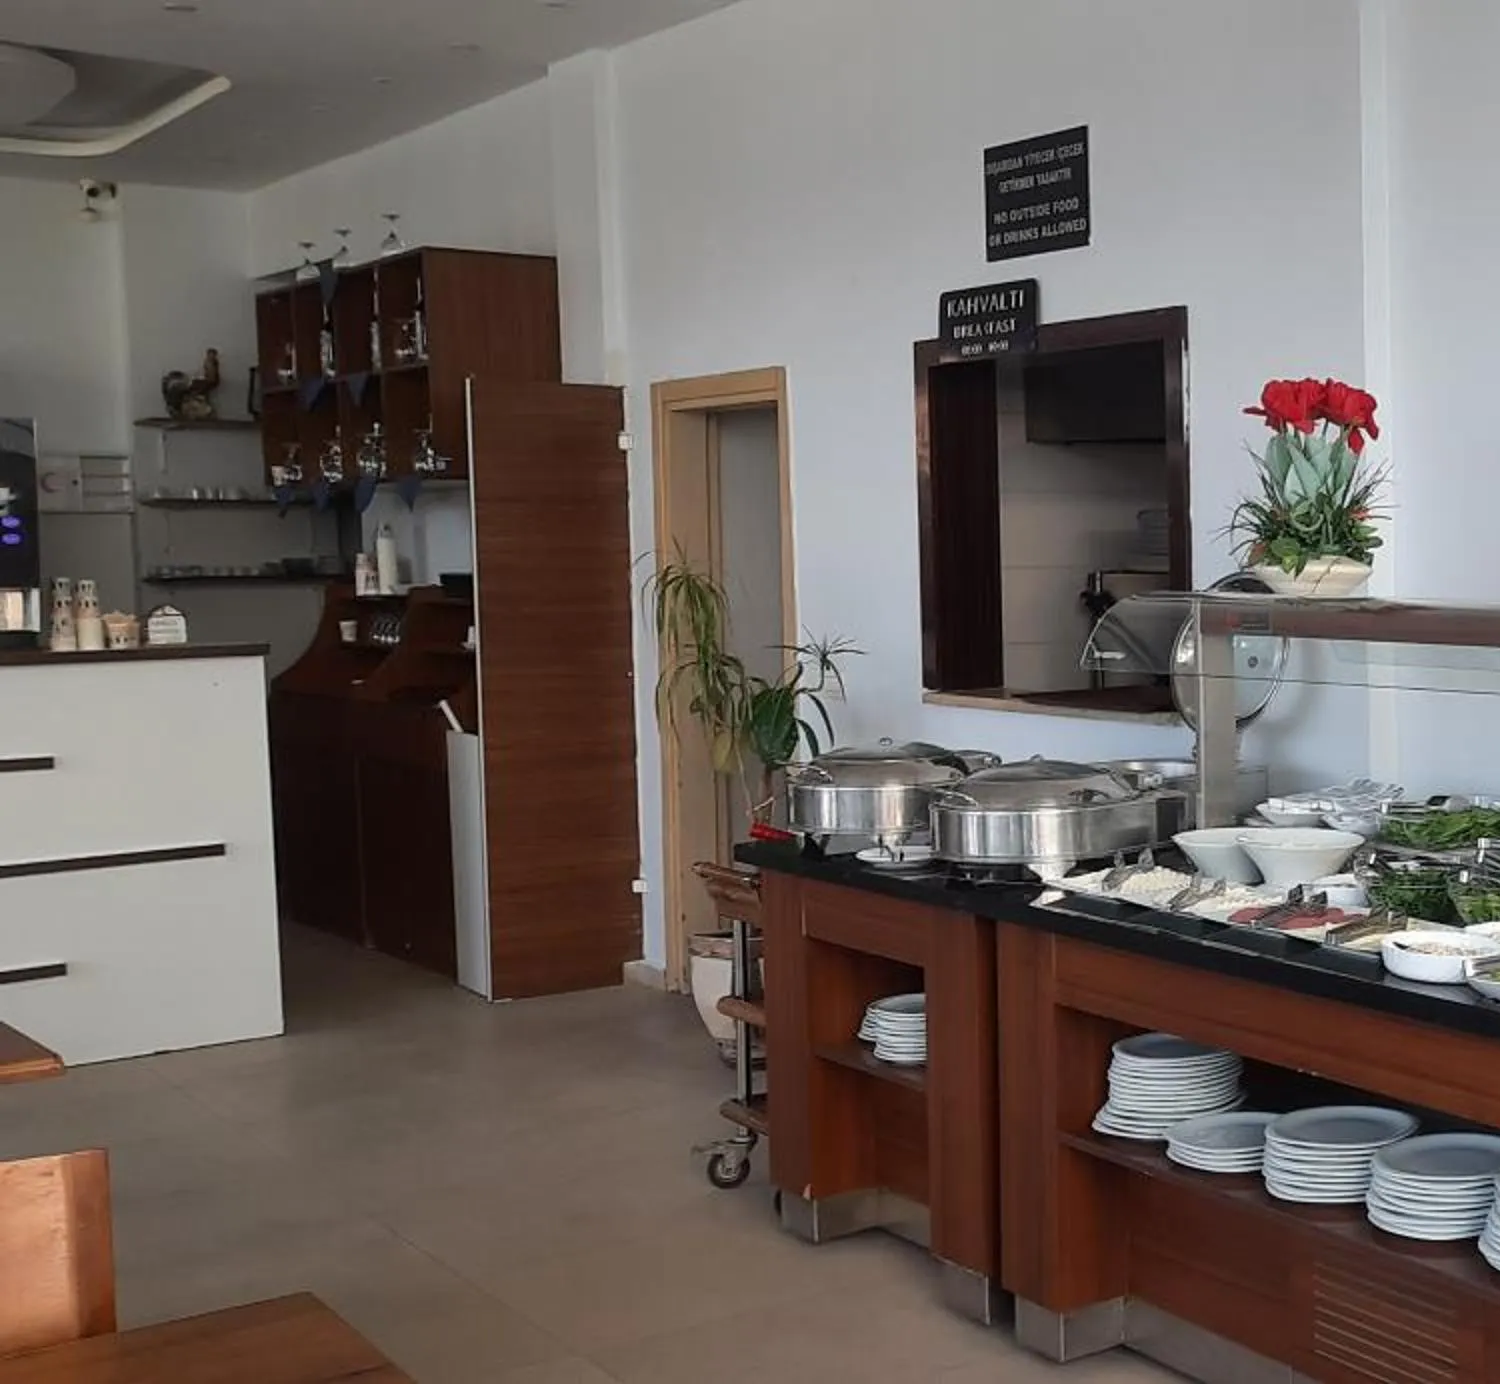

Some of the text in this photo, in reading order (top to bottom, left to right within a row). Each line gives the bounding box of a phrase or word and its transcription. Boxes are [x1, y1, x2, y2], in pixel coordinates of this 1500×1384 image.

[993, 196, 1080, 225] NO OUTSIDE FOOD
[989, 217, 1087, 247] OR DRINKS ALLOWED
[947, 289, 1024, 318] KAHVALTI
[953, 317, 1017, 339] BREAKFAST
